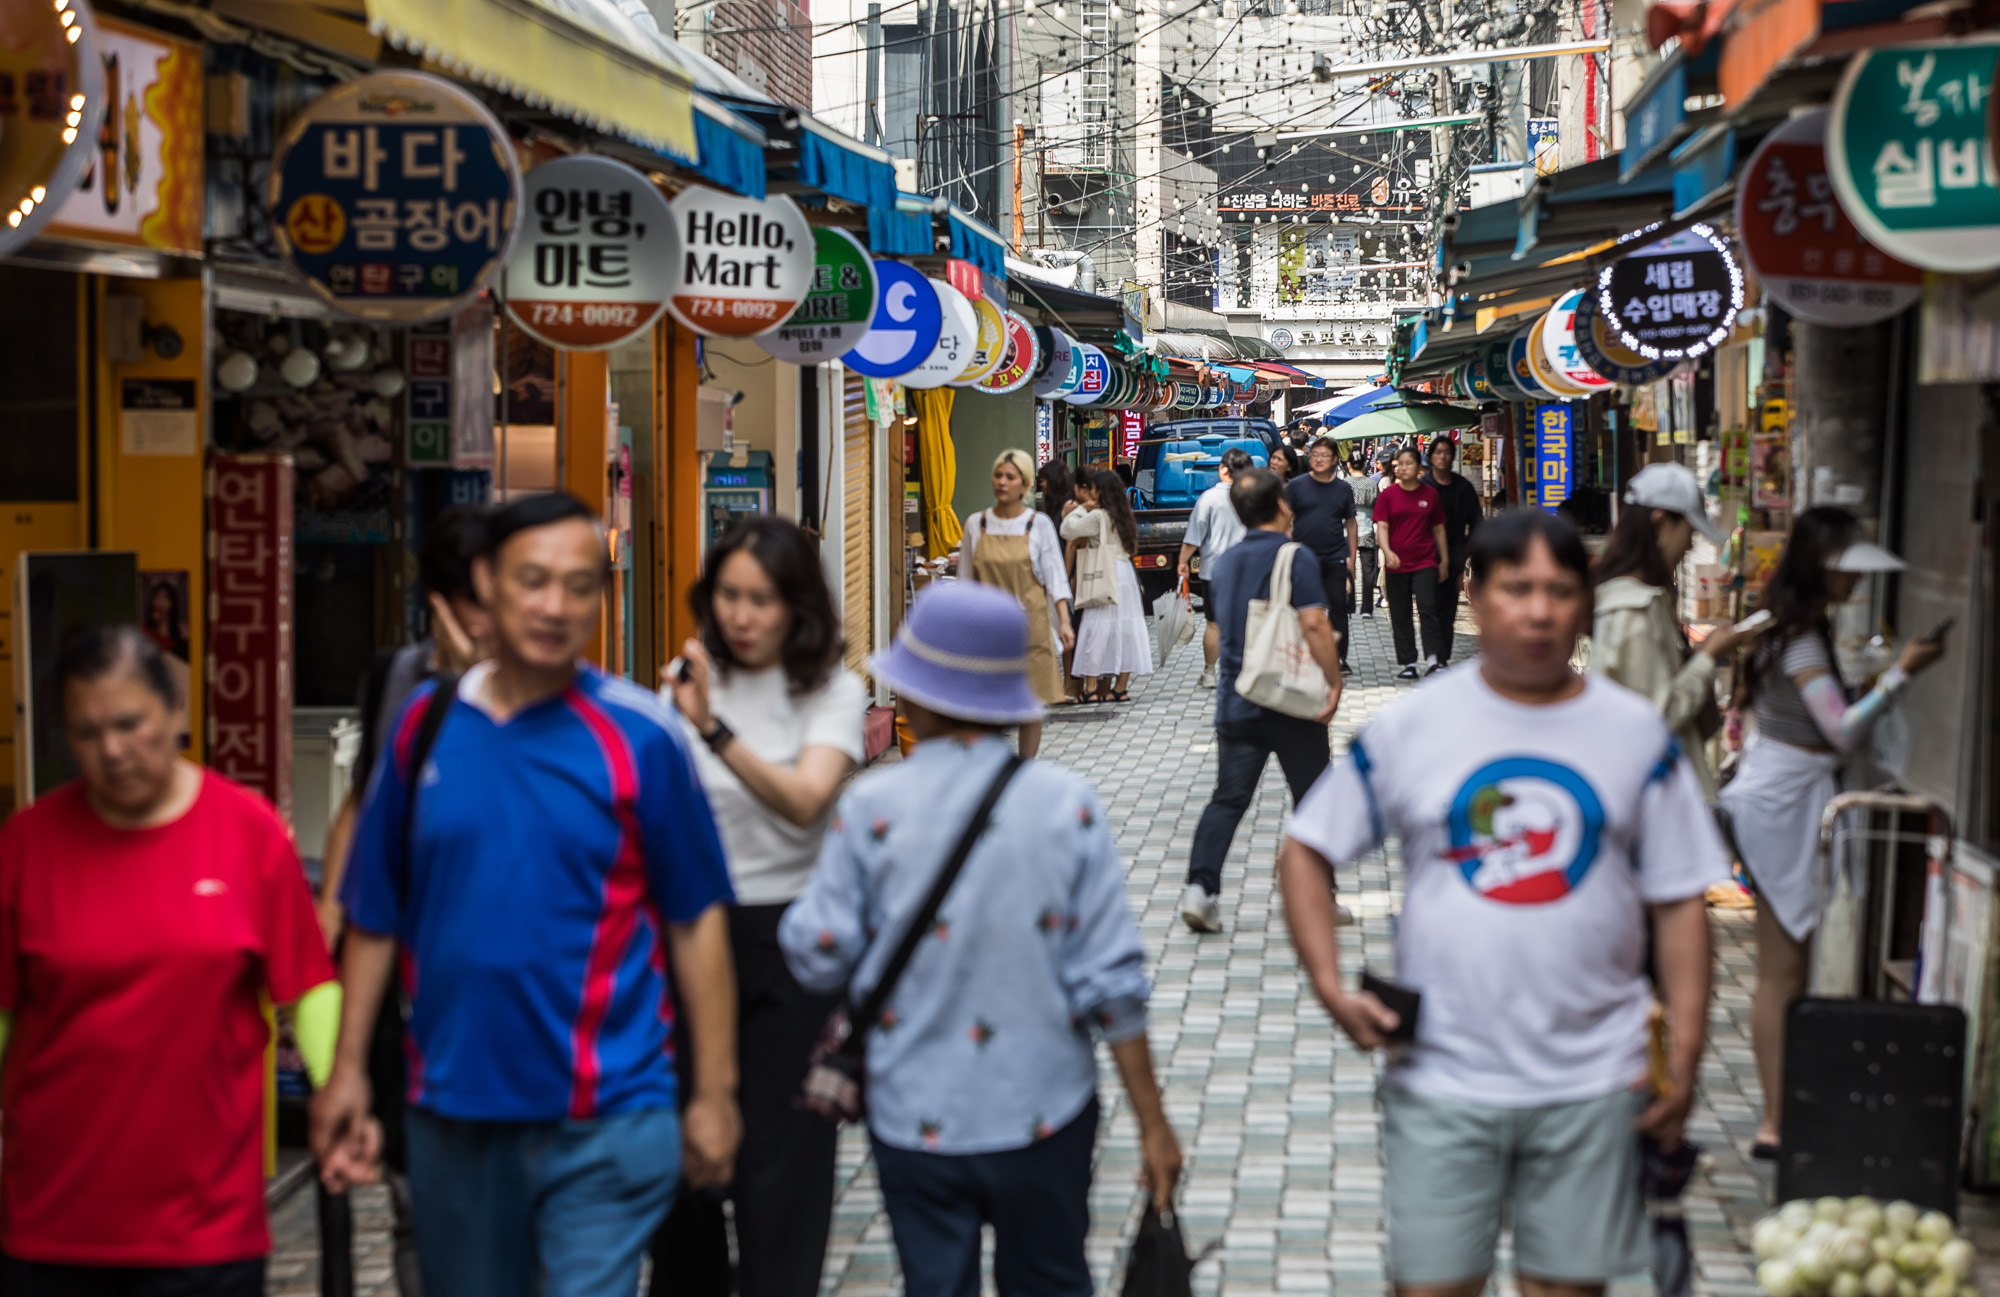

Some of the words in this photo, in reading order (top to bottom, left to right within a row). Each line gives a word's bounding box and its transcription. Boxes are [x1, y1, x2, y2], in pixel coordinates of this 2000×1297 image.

[322, 127, 465, 191] 바다
[535, 187, 646, 240] 안녕,
[1231, 194, 1267, 208] 진심을
[1271, 193, 1308, 208] 다하는
[292, 201, 337, 248] 산
[352, 198, 501, 251] 곰장어
[688, 211, 793, 251] Hello,
[535, 243, 632, 289] 마트
[684, 252, 781, 289] Mart
[531, 304, 637, 328] 724-0092
[691, 299, 777, 320] 724-0092
[794, 293, 849, 322] ORE
[1622, 289, 1722, 323] 수입매장
[939, 335, 960, 361] 당
[1299, 330, 1377, 347] 구포국수
[1054, 351, 1070, 362] RE
[1086, 355, 1099, 368] 치
[1083, 369, 1101, 391] 집
[1038, 405, 1051, 441] 자갈치
[1541, 409, 1569, 507] 한국마트
[217, 472, 269, 790] 연탄구이전
